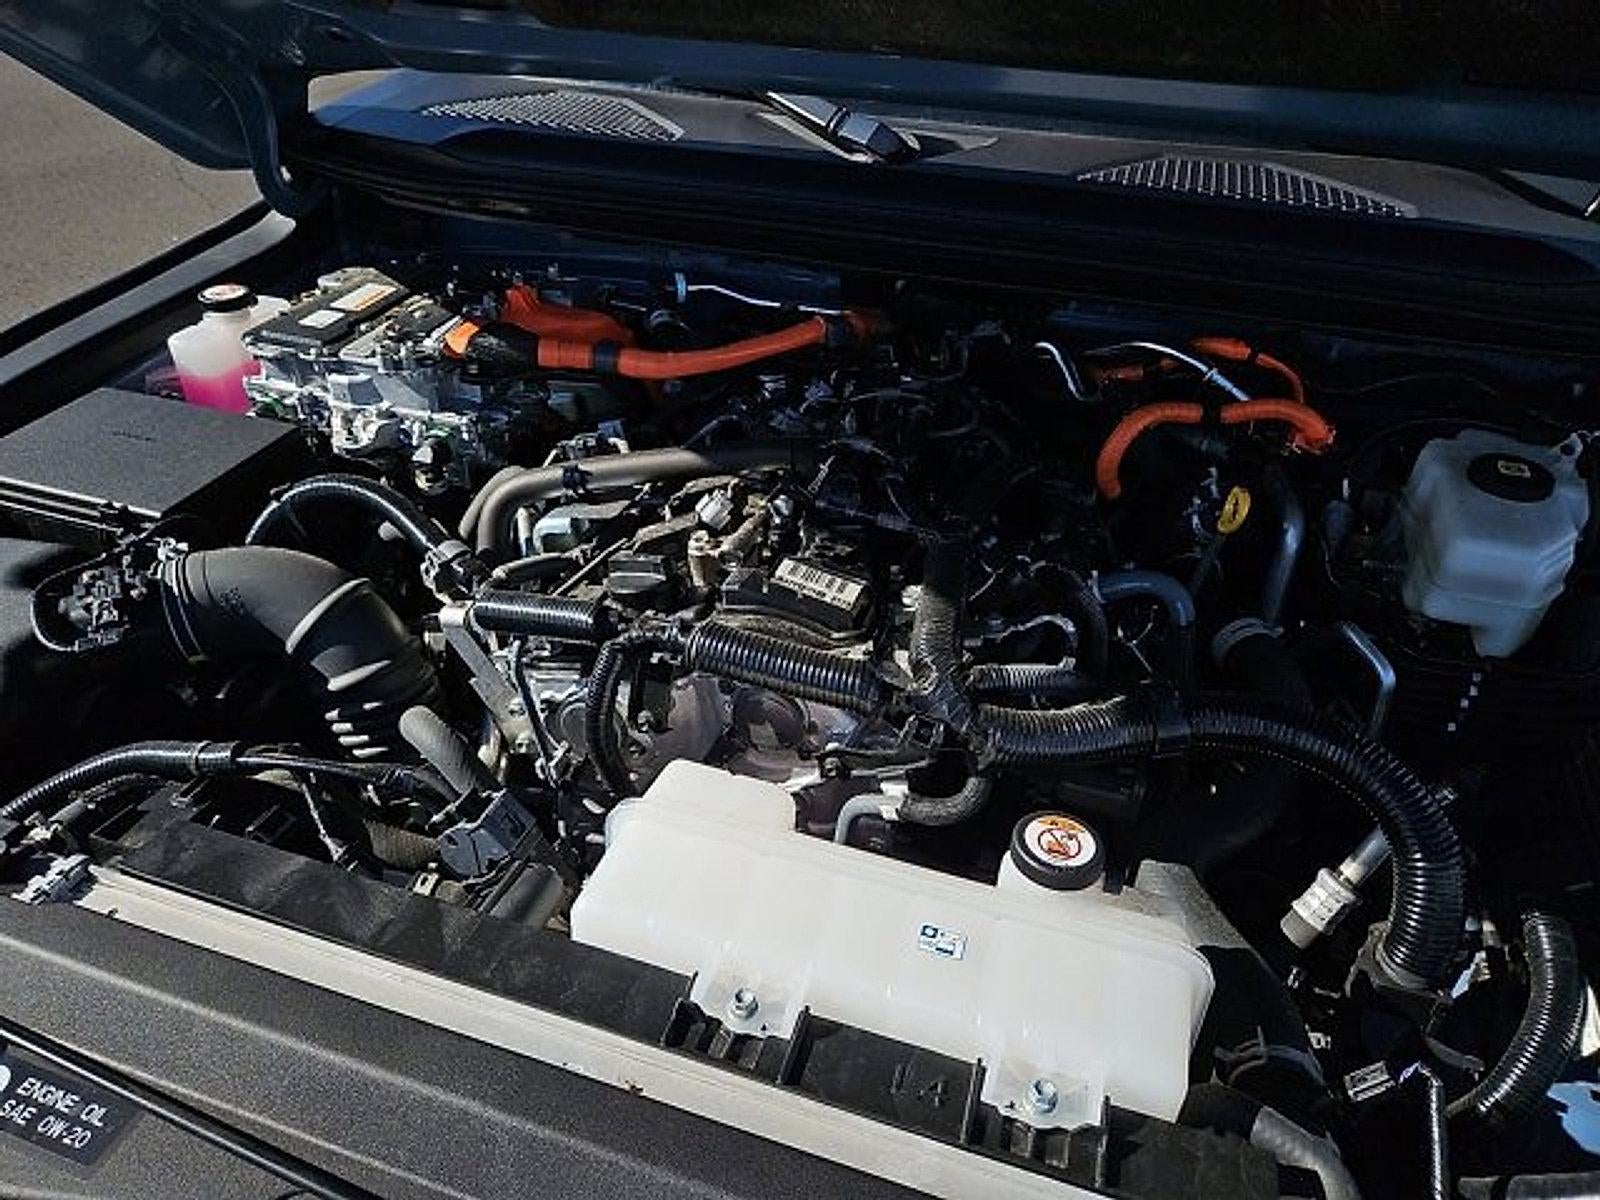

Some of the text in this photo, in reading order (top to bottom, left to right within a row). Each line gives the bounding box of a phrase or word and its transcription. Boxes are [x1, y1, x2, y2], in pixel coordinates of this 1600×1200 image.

[0, 1099, 36, 1126] SAE
[16, 1077, 107, 1127] ENGINE OIL
